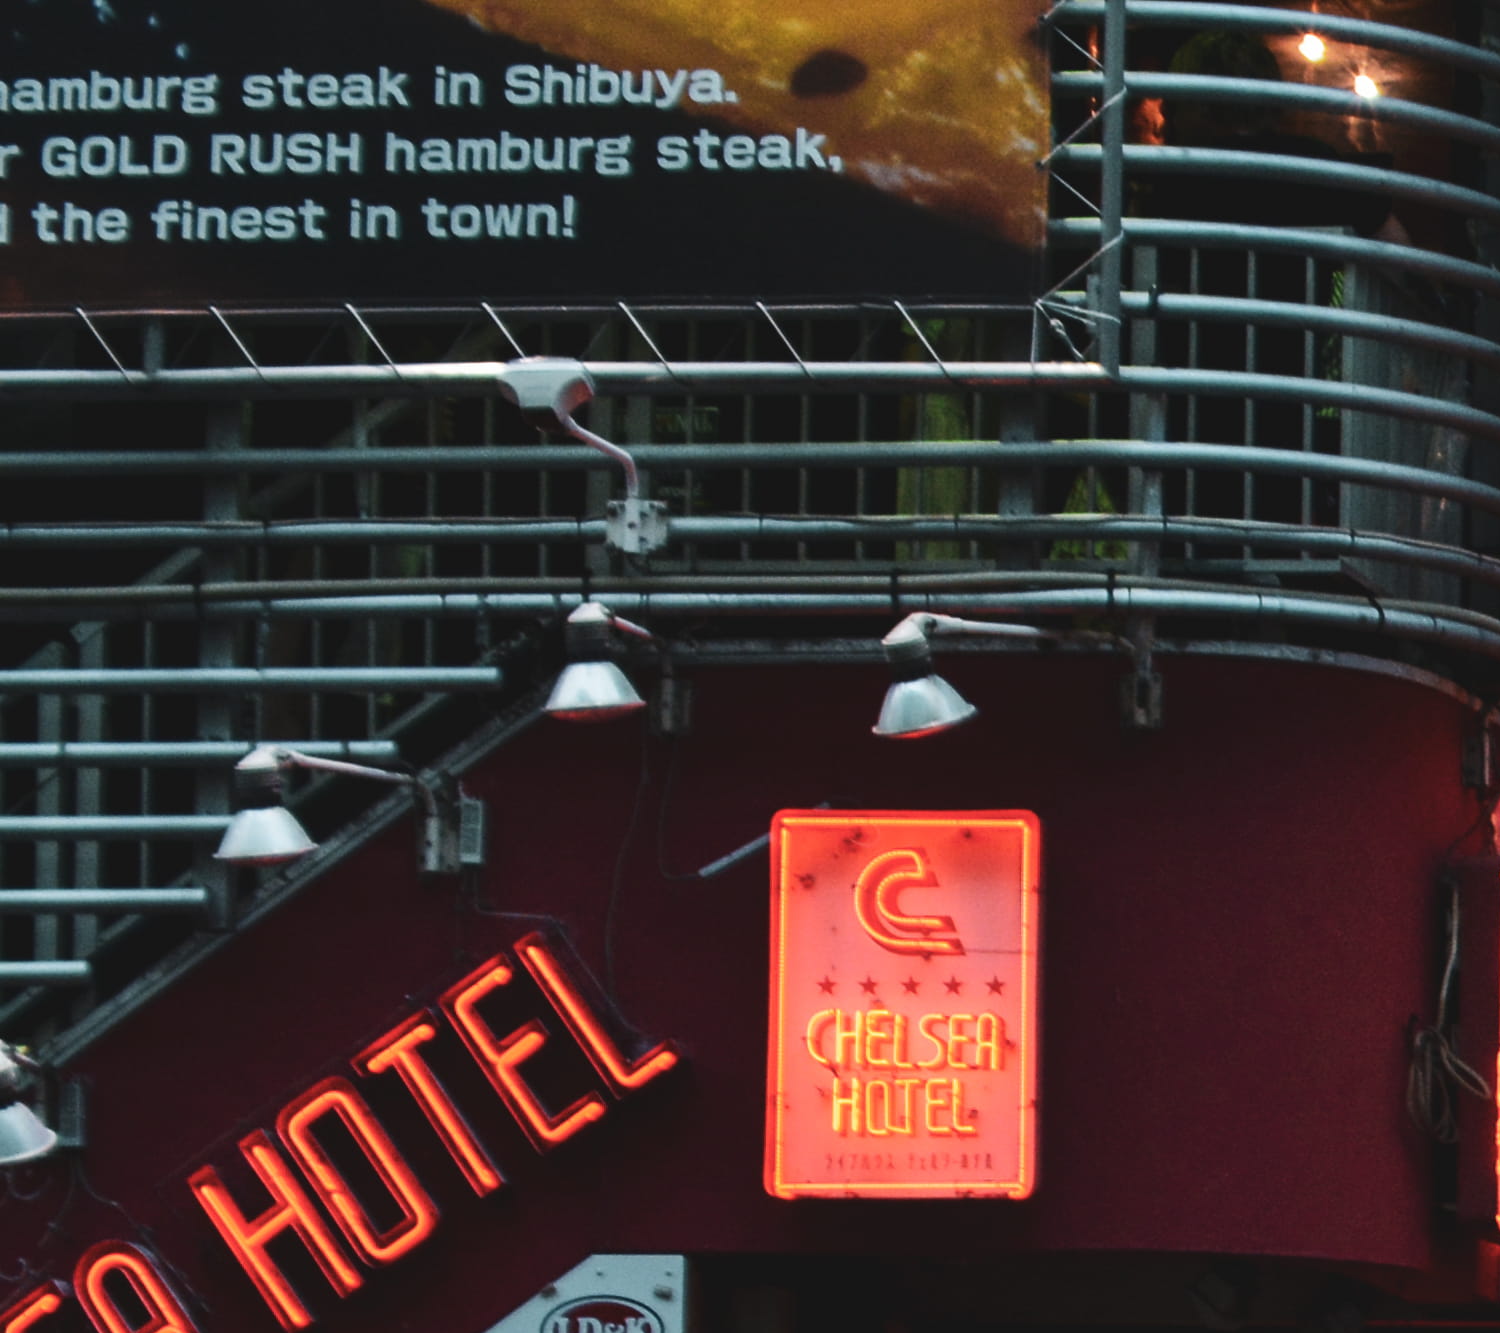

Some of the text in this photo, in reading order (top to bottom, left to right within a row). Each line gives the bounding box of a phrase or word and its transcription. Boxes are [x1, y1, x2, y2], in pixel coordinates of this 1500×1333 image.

[242, 66, 408, 108] steak
[434, 65, 477, 105] in
[504, 63, 739, 115] Shibuya.
[41, 135, 187, 177] GOLD
[210, 132, 362, 175] RUSH
[385, 131, 631, 177] hamburg
[656, 126, 843, 175] steak,
[31, 195, 576, 243] the finest in town!
[806, 1008, 1004, 1072] CHELSEA
[187, 930, 682, 1333] HOTEL
[831, 1077, 980, 1138] HOTEL
